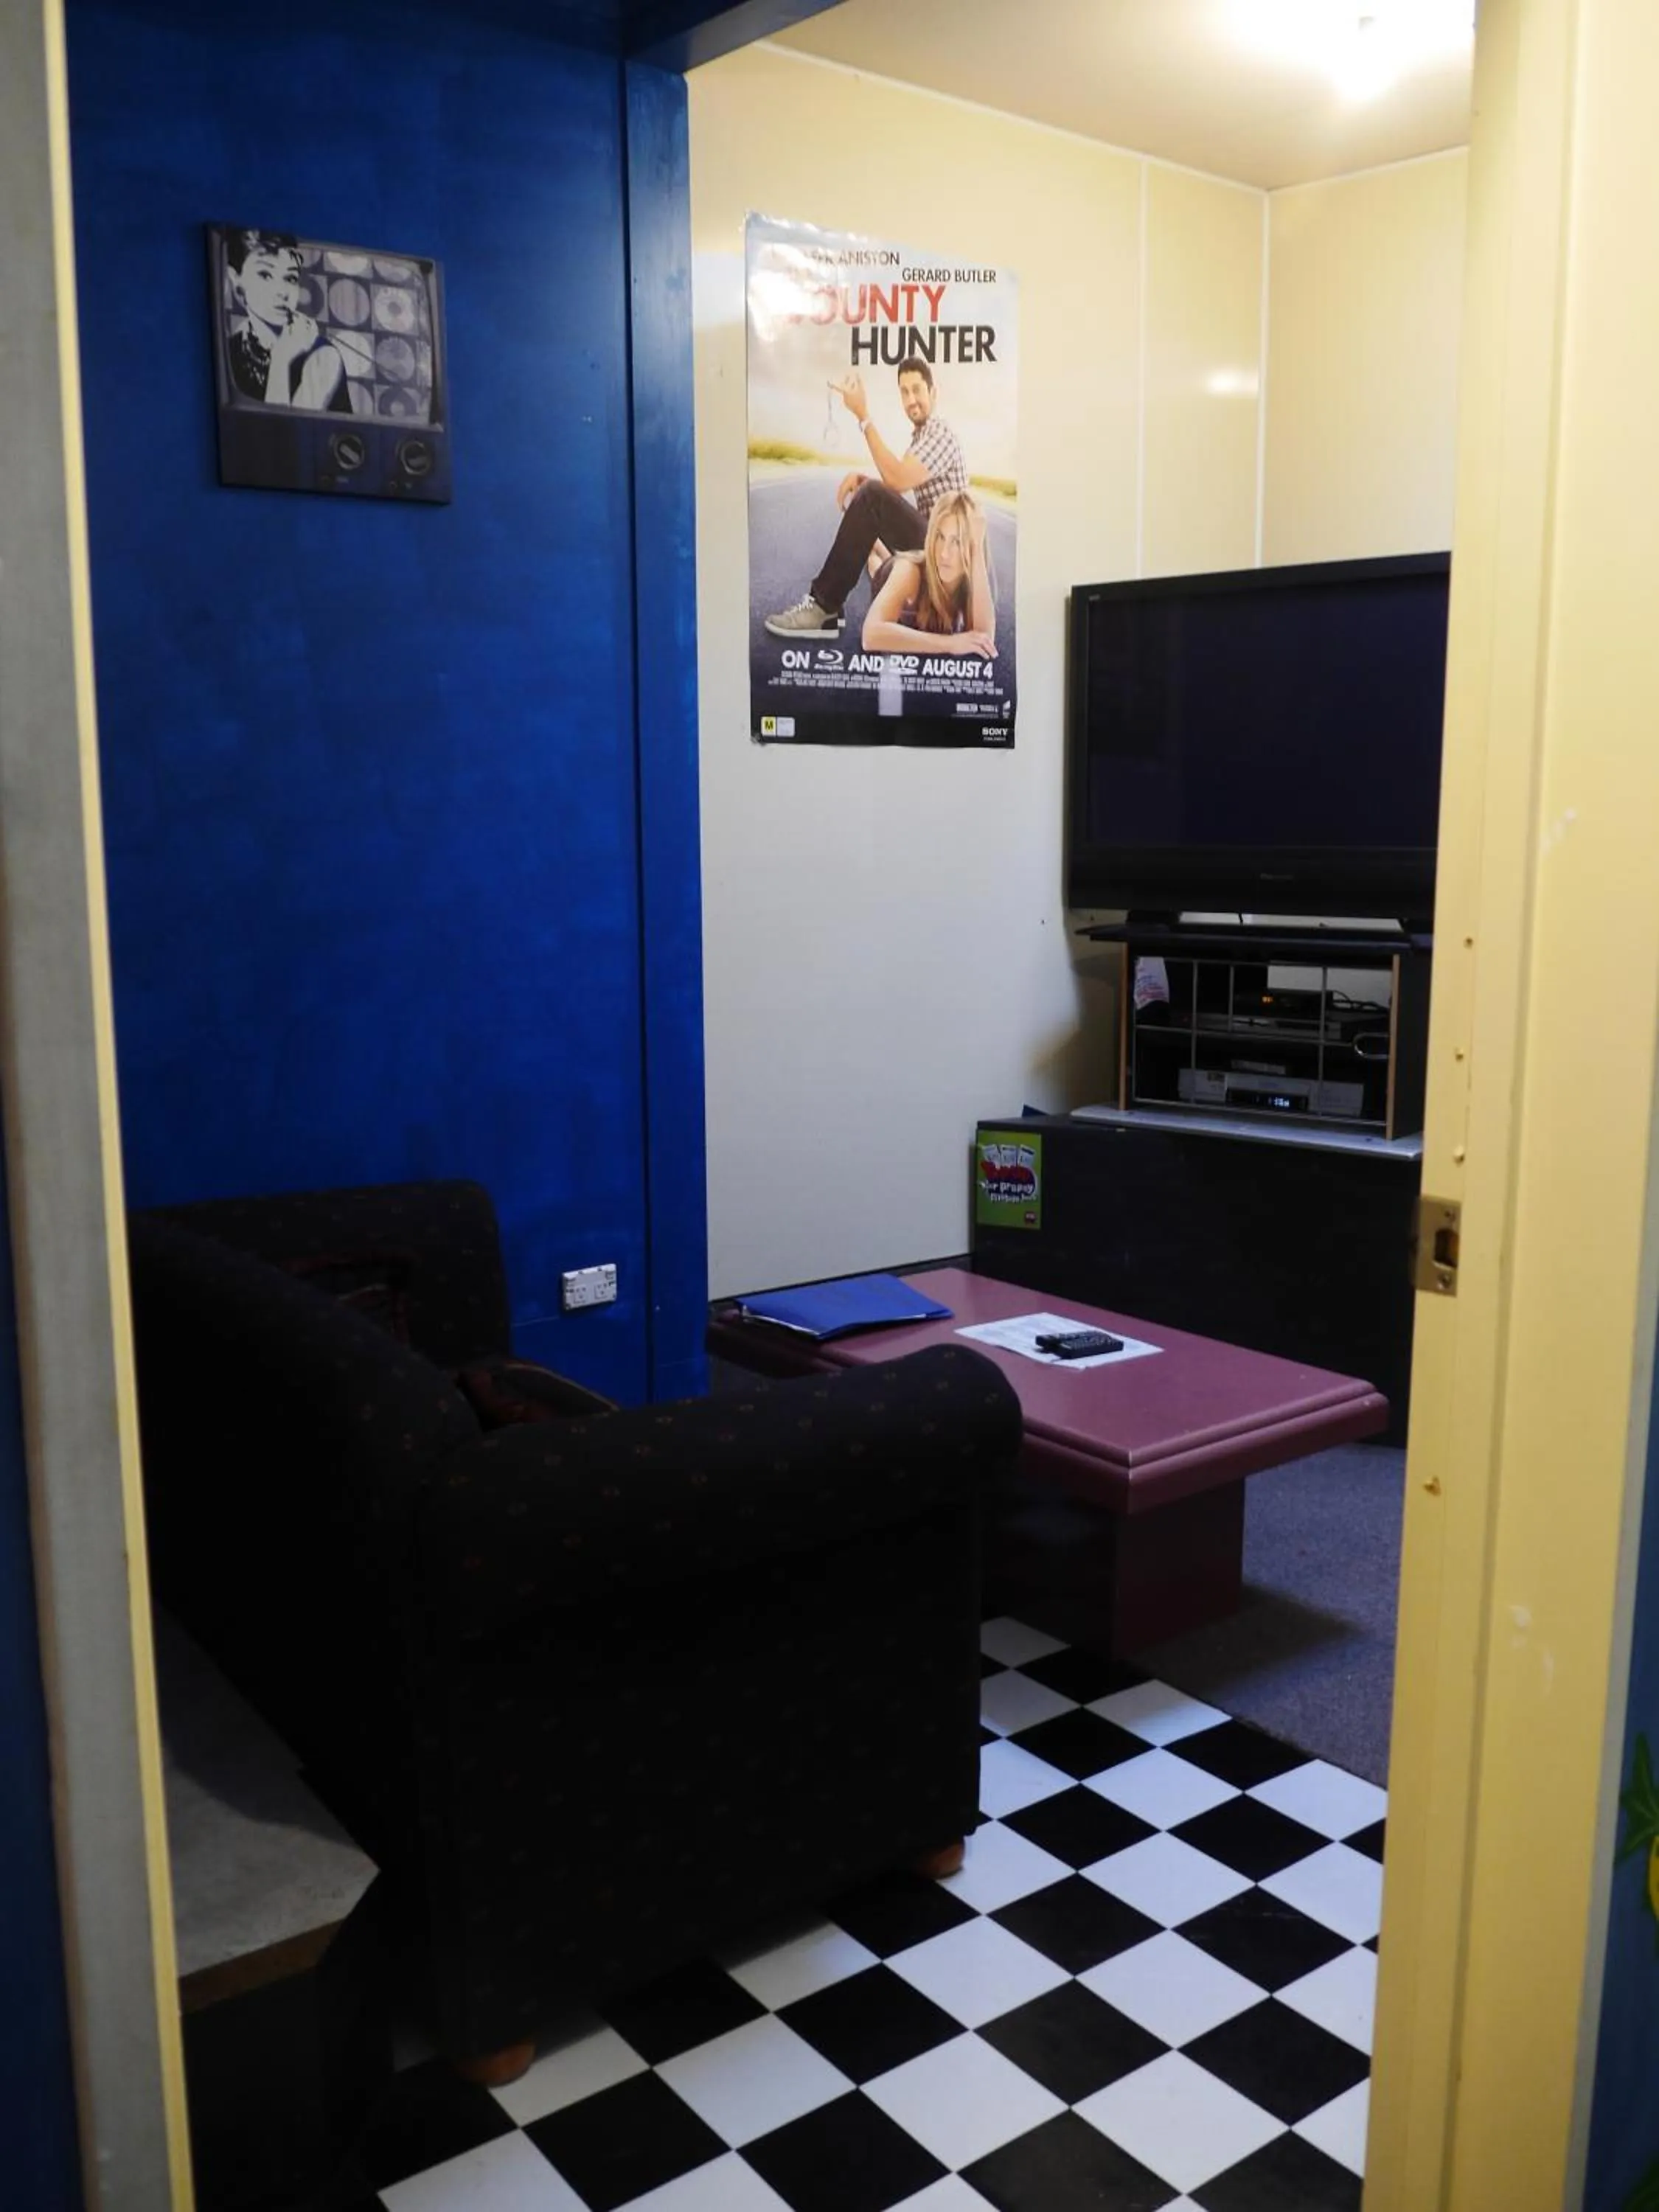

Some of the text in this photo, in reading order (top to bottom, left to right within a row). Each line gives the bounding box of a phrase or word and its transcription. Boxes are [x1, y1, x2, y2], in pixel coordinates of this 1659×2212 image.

[839, 249, 900, 265] ANISTON
[902, 267, 997, 284] GERARD BUTLER
[785, 283, 947, 325] OUNTY
[851, 324, 998, 366] HUNTER
[781, 650, 994, 680] ON AND DVD AUGUST 4
[981, 726, 1009, 737] SONY
